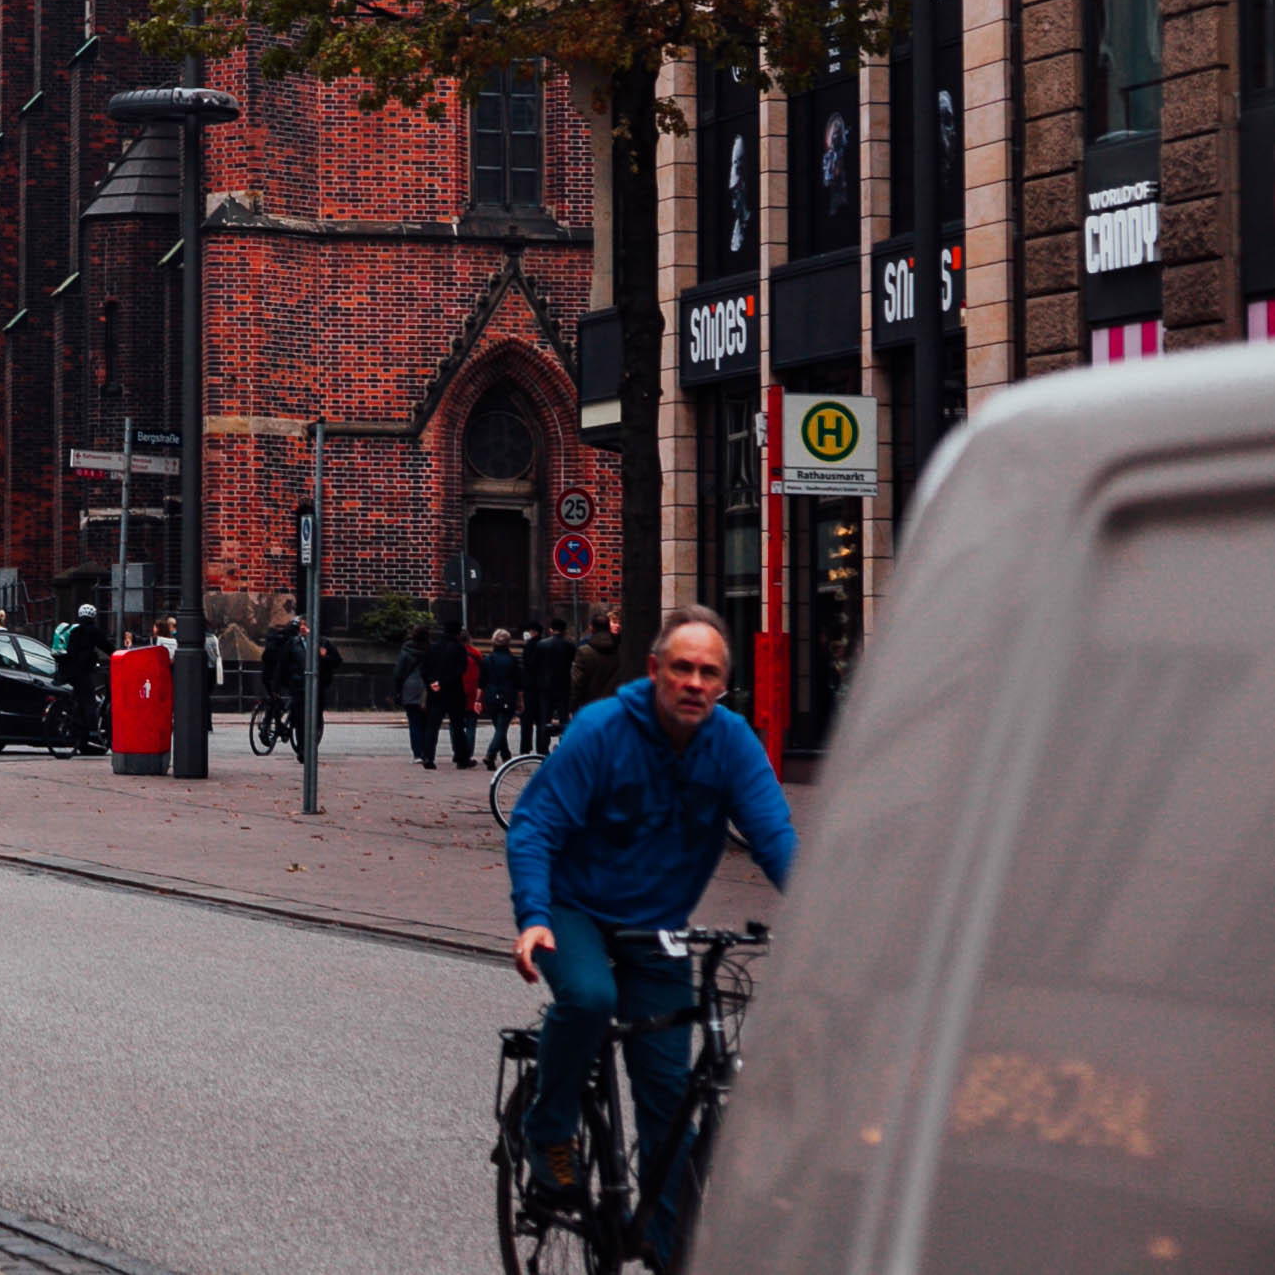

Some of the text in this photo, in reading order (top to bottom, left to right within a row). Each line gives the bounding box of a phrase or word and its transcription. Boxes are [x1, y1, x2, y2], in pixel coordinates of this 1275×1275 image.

[1089, 181, 1154, 210] WORLD OF
[1085, 203, 1157, 273] CANDY
[884, 248, 953, 323] snis
[690, 296, 747, 370] snipes
[137, 431, 181, 445] Bergstraße
[817, 416, 842, 448] H
[797, 470, 865, 482] Rathausmarkt
[564, 499, 586, 520] 25
